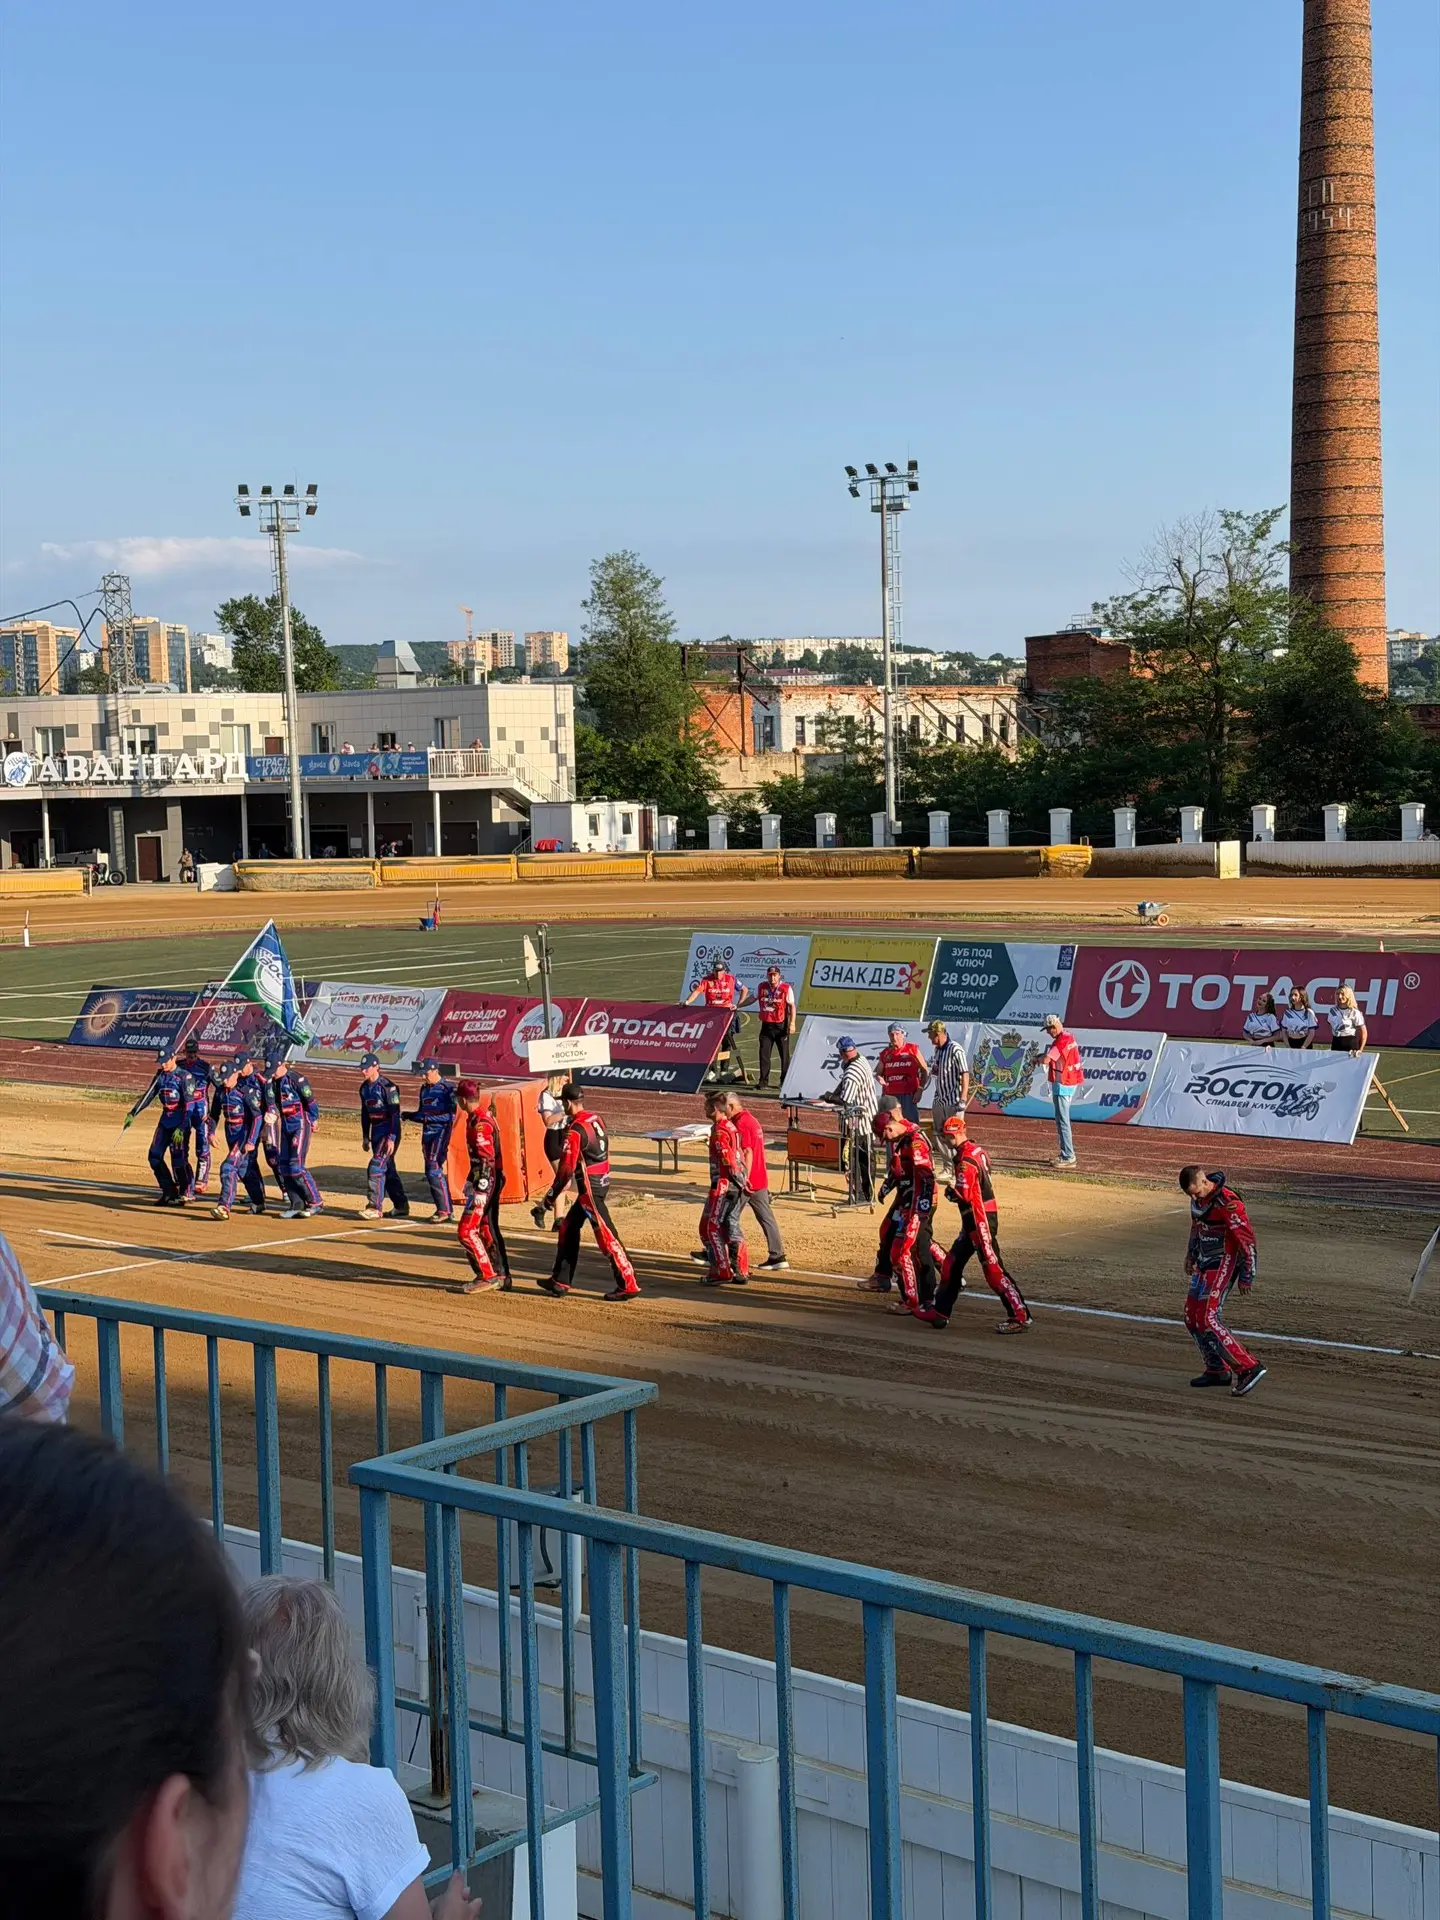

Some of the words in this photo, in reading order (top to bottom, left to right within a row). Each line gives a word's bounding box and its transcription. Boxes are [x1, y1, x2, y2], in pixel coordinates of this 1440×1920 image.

[37, 752, 250, 783] АВАНГАРД
[262, 766, 269, 776] К
[951, 947, 970, 957] ЗУБ
[971, 948, 993, 959] ПОД
[955, 958, 986, 968] КЛЮЧ
[820, 965, 868, 984] ЗНАК
[868, 967, 896, 987] ДВ
[940, 971, 959, 985] 28
[943, 990, 987, 1000] ИМПЛАНТ
[1158, 973, 1400, 1016] TOTACHI
[444, 1009, 507, 1021] АВТОРАДИО
[943, 1004, 979, 1014] КОРОНКА
[518, 1025, 543, 1035] АВТО
[611, 1018, 706, 1039] TOTACHI
[463, 1033, 500, 1043] РОССИИ
[609, 1038, 662, 1047] АВТОТОВАРЫ
[664, 1041, 697, 1049] ЯПОНИЯ
[1083, 1068, 1147, 1082] МОРСКОГО
[1183, 1075, 1308, 1102] ВОСТОК
[1099, 1093, 1141, 1108] КРАЯ
[1205, 1098, 1250, 1109] СПИДВЕЙ
[1251, 1101, 1278, 1111] КЛУБ
